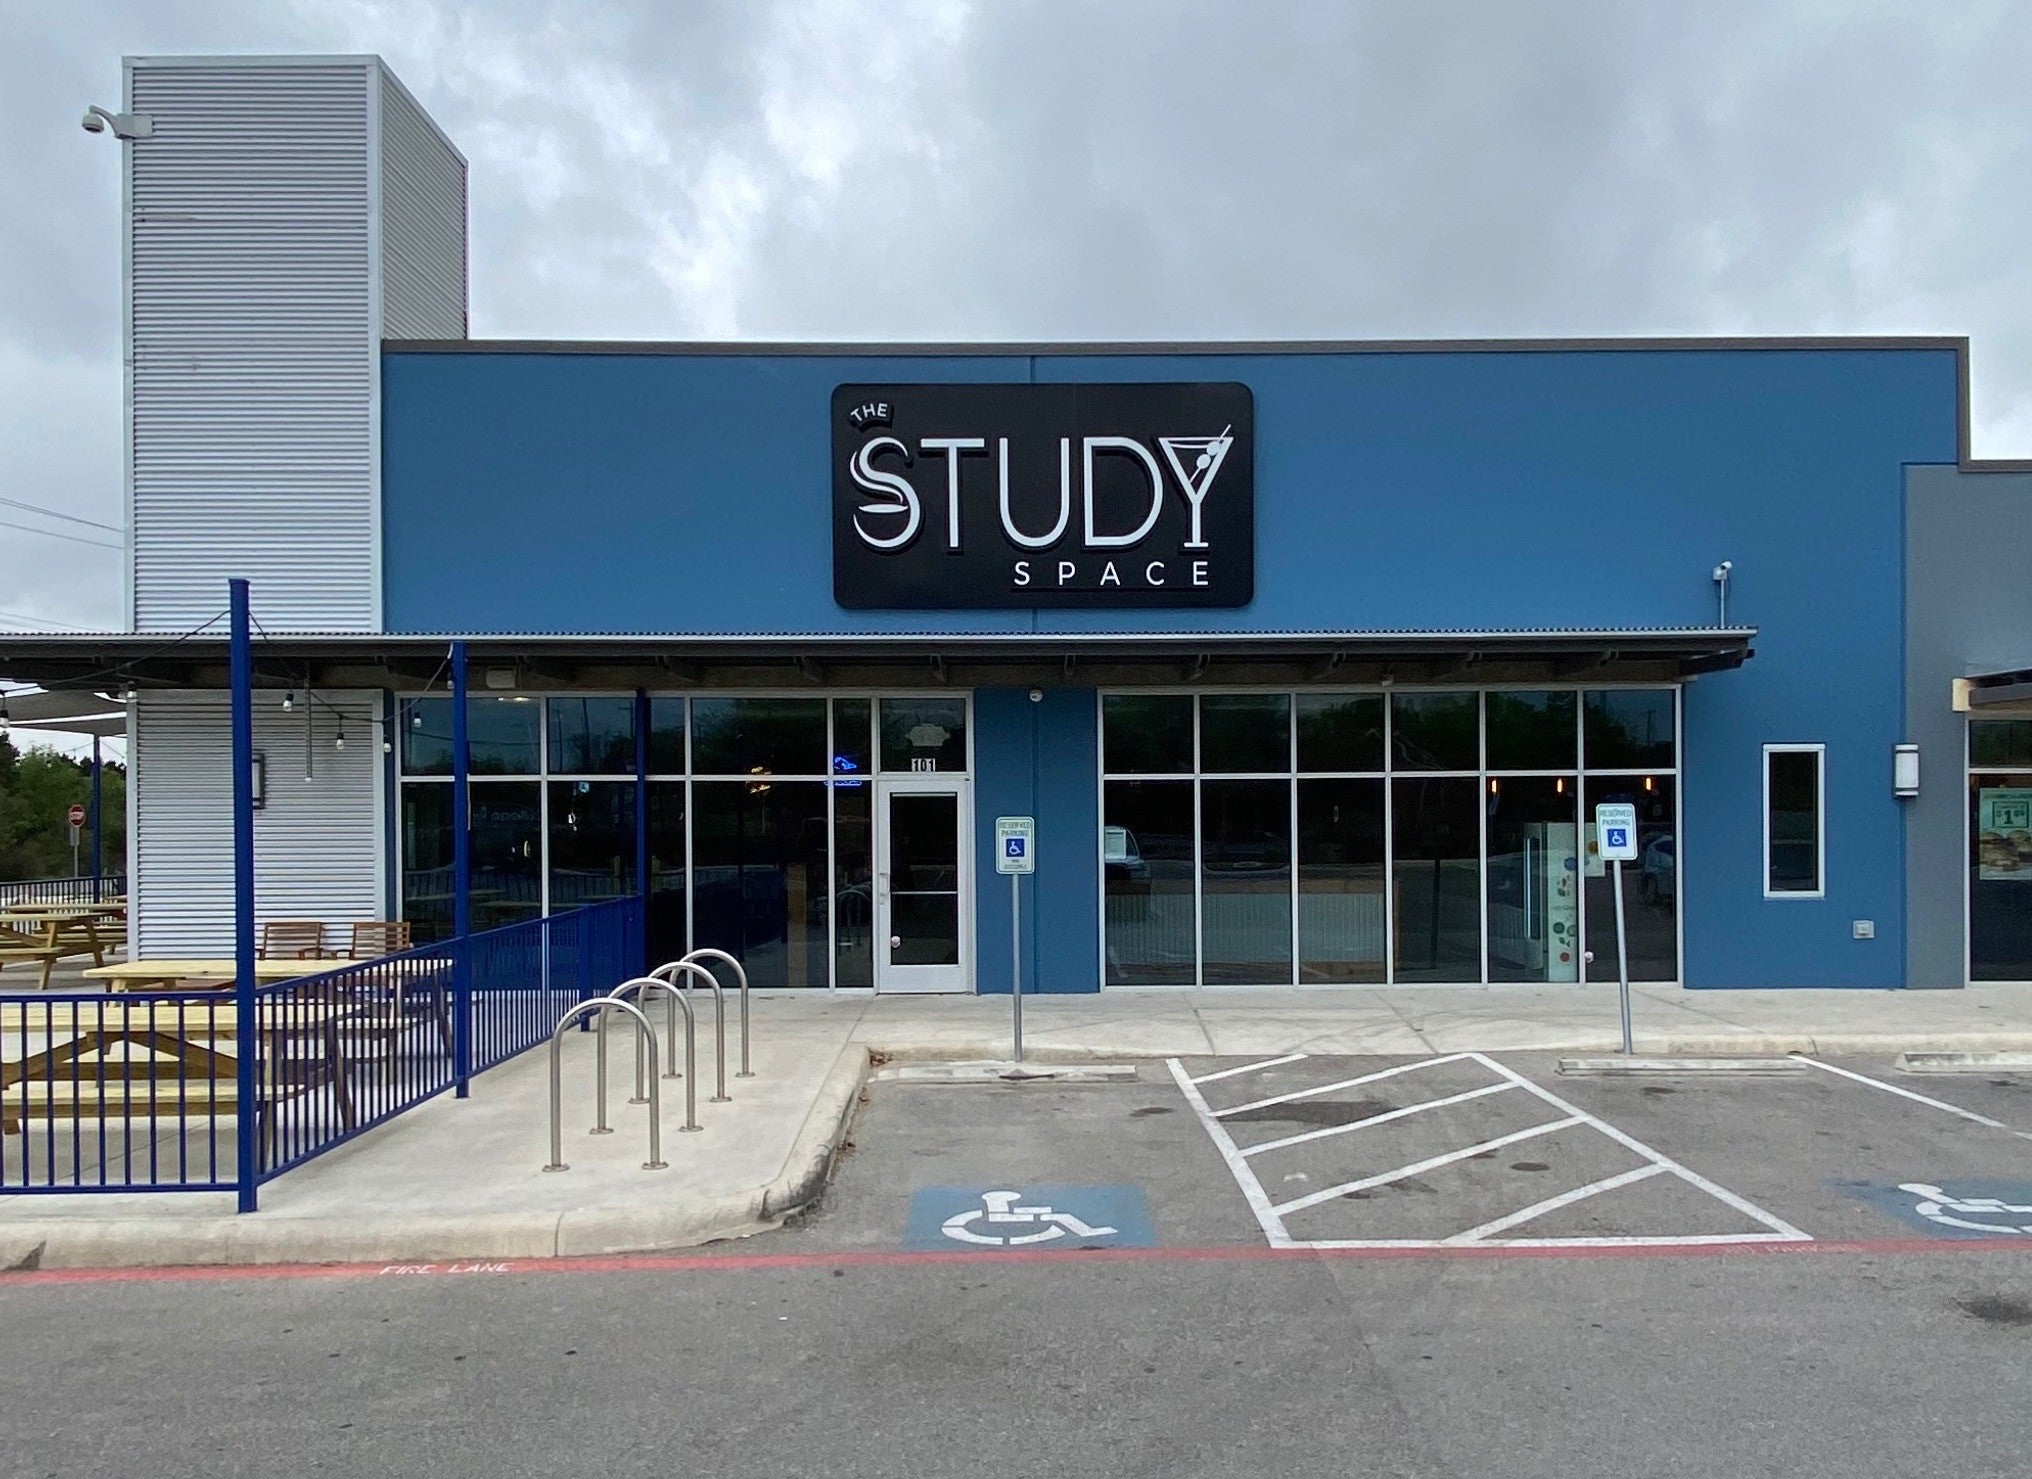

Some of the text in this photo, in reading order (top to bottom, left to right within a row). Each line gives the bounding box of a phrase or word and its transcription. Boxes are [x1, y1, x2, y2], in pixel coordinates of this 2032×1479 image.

[850, 403, 888, 421] THE
[850, 426, 1234, 548] STUDY
[1014, 561, 1209, 586] SPACE
[913, 758, 935, 772] 101
[379, 1262, 515, 1275] FIRE LANE
